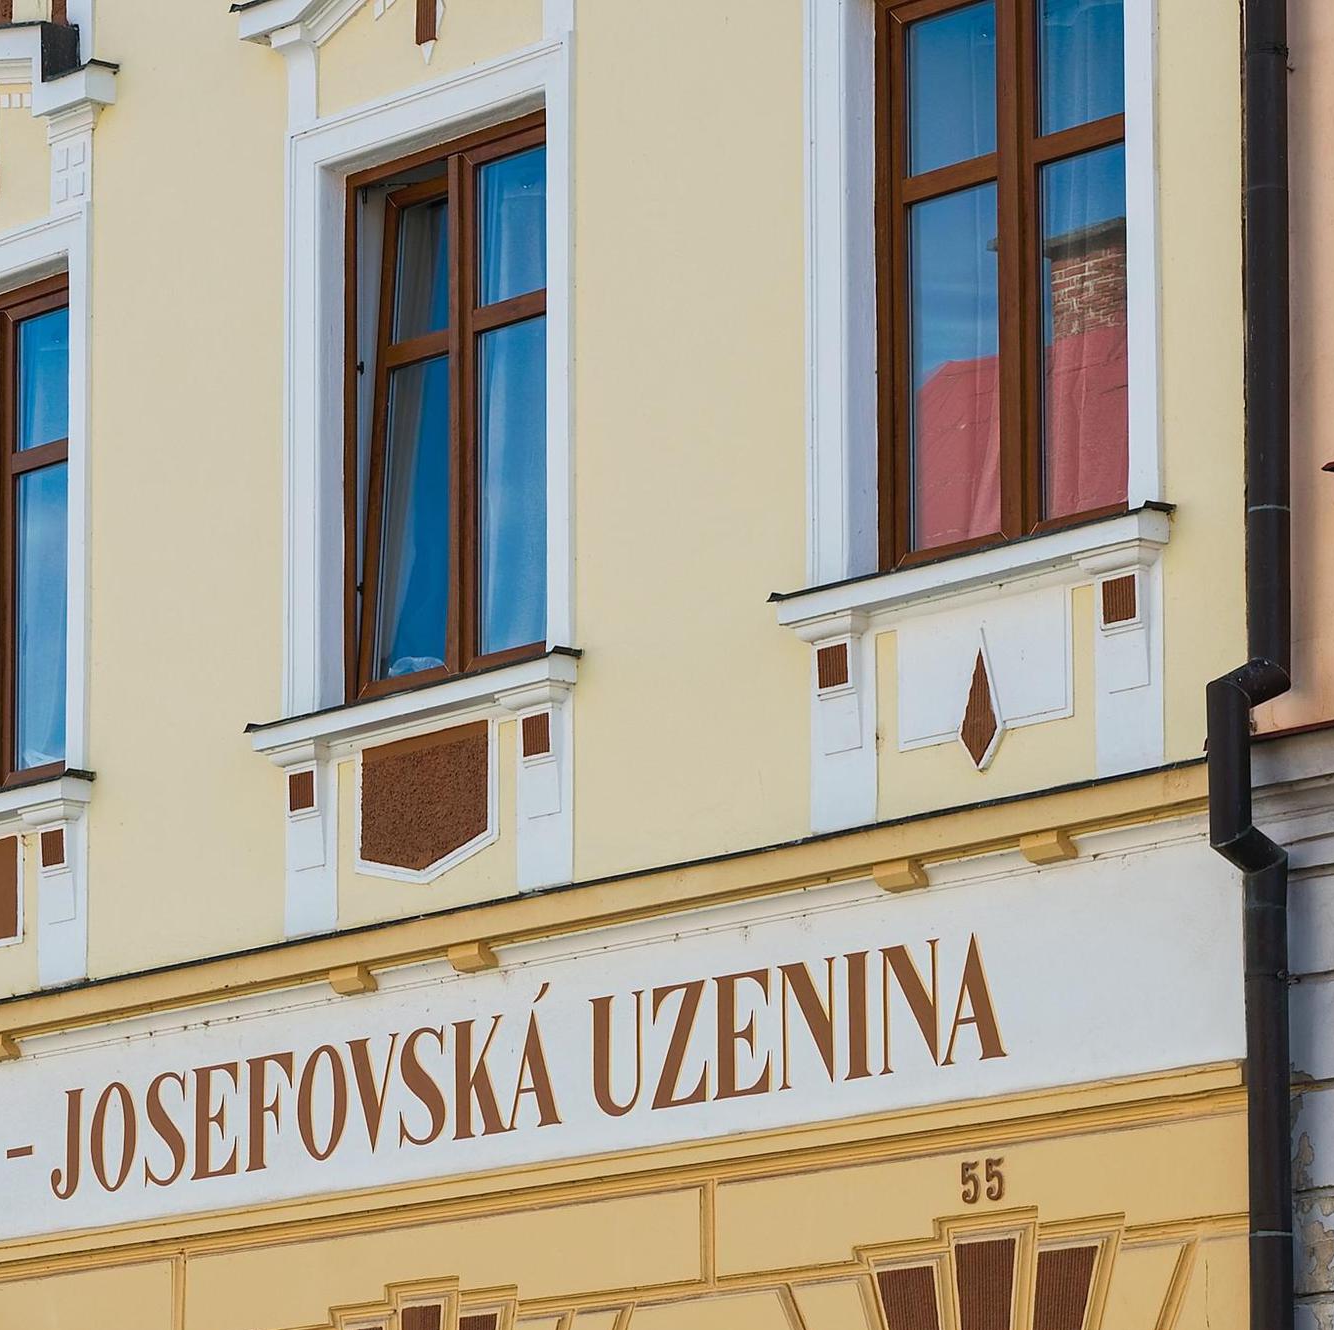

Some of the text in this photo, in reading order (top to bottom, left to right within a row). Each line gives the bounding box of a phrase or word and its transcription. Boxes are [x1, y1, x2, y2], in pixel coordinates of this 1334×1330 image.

[49, 982, 562, 1201] JOSEFOVSKÁ
[589, 932, 1008, 1117] UZENINA
[961, 1157, 1005, 1204] 55
